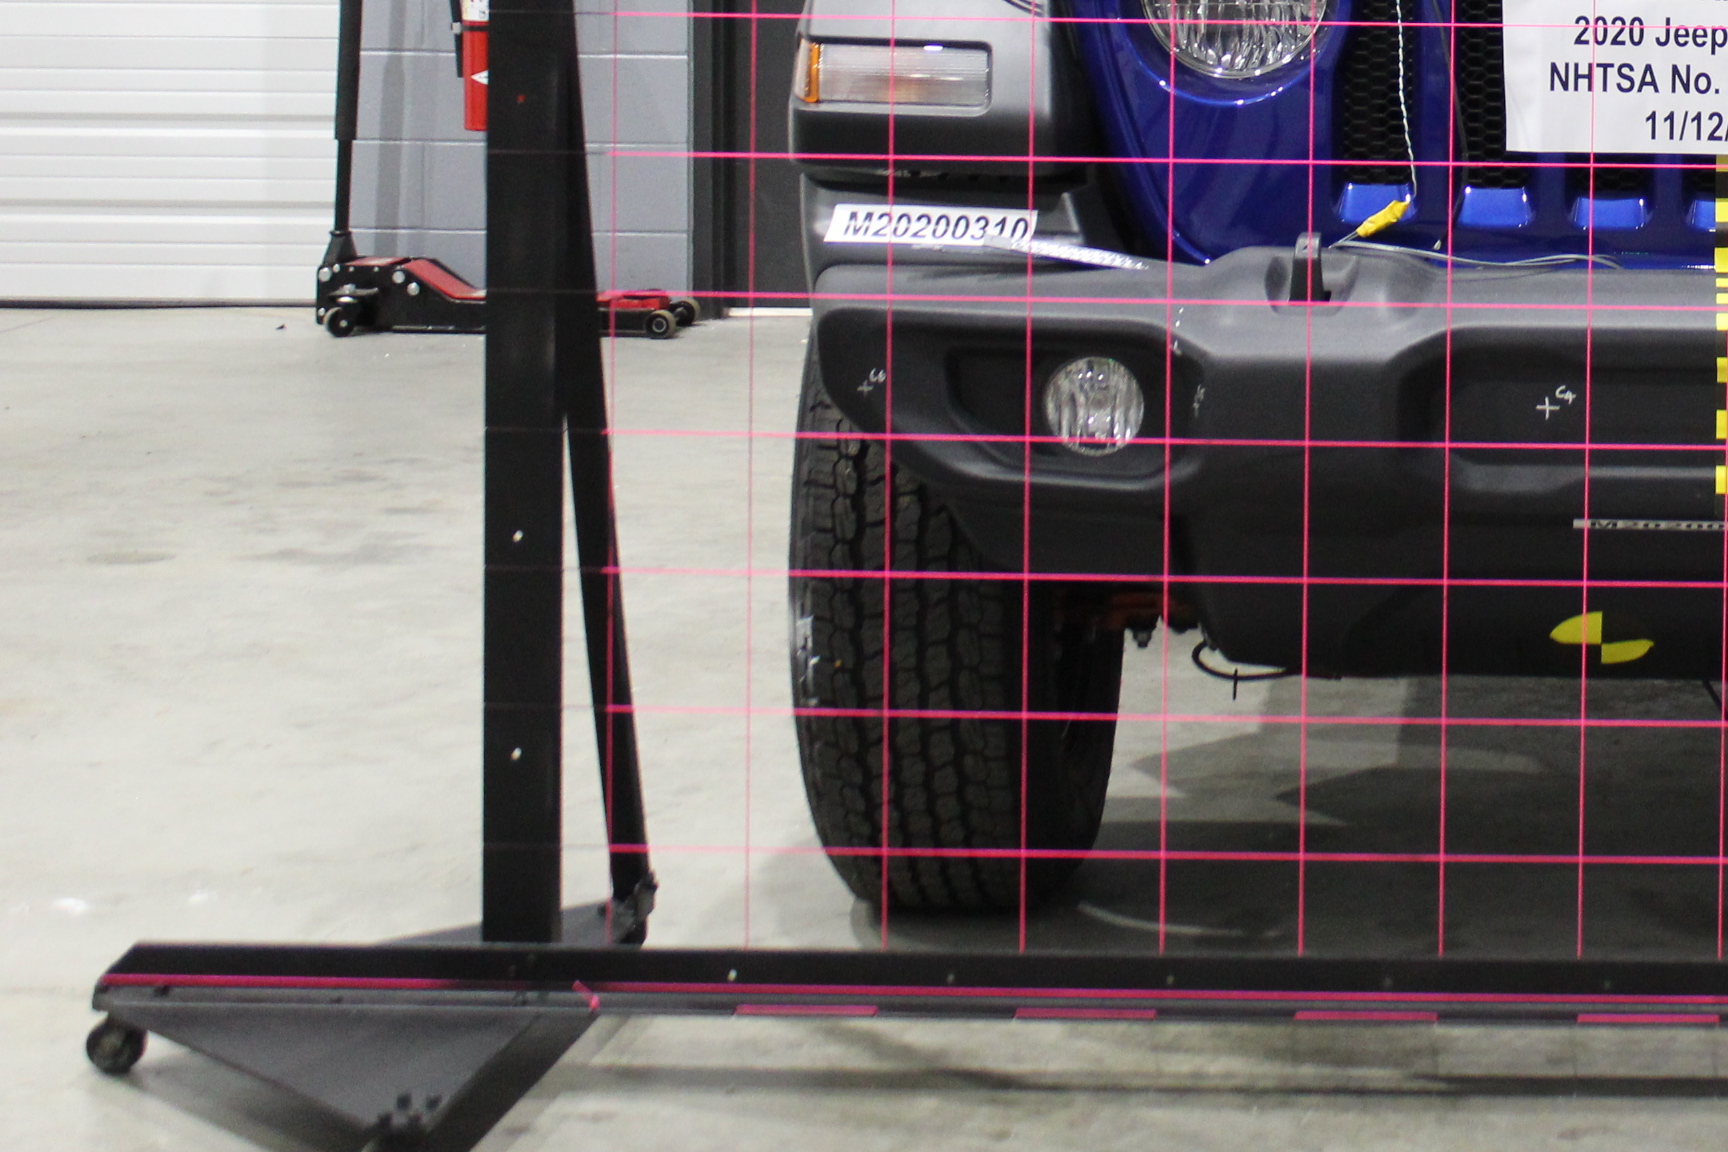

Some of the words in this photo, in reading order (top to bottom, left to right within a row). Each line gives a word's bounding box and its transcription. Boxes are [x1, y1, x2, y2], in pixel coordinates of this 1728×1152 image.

[1574, 15, 1645, 46] 2020
[1655, 17, 1728, 56] Jeep
[1549, 61, 1660, 94] NHTSA
[1671, 64, 1720, 95] No.
[843, 210, 1029, 241] M20200310
